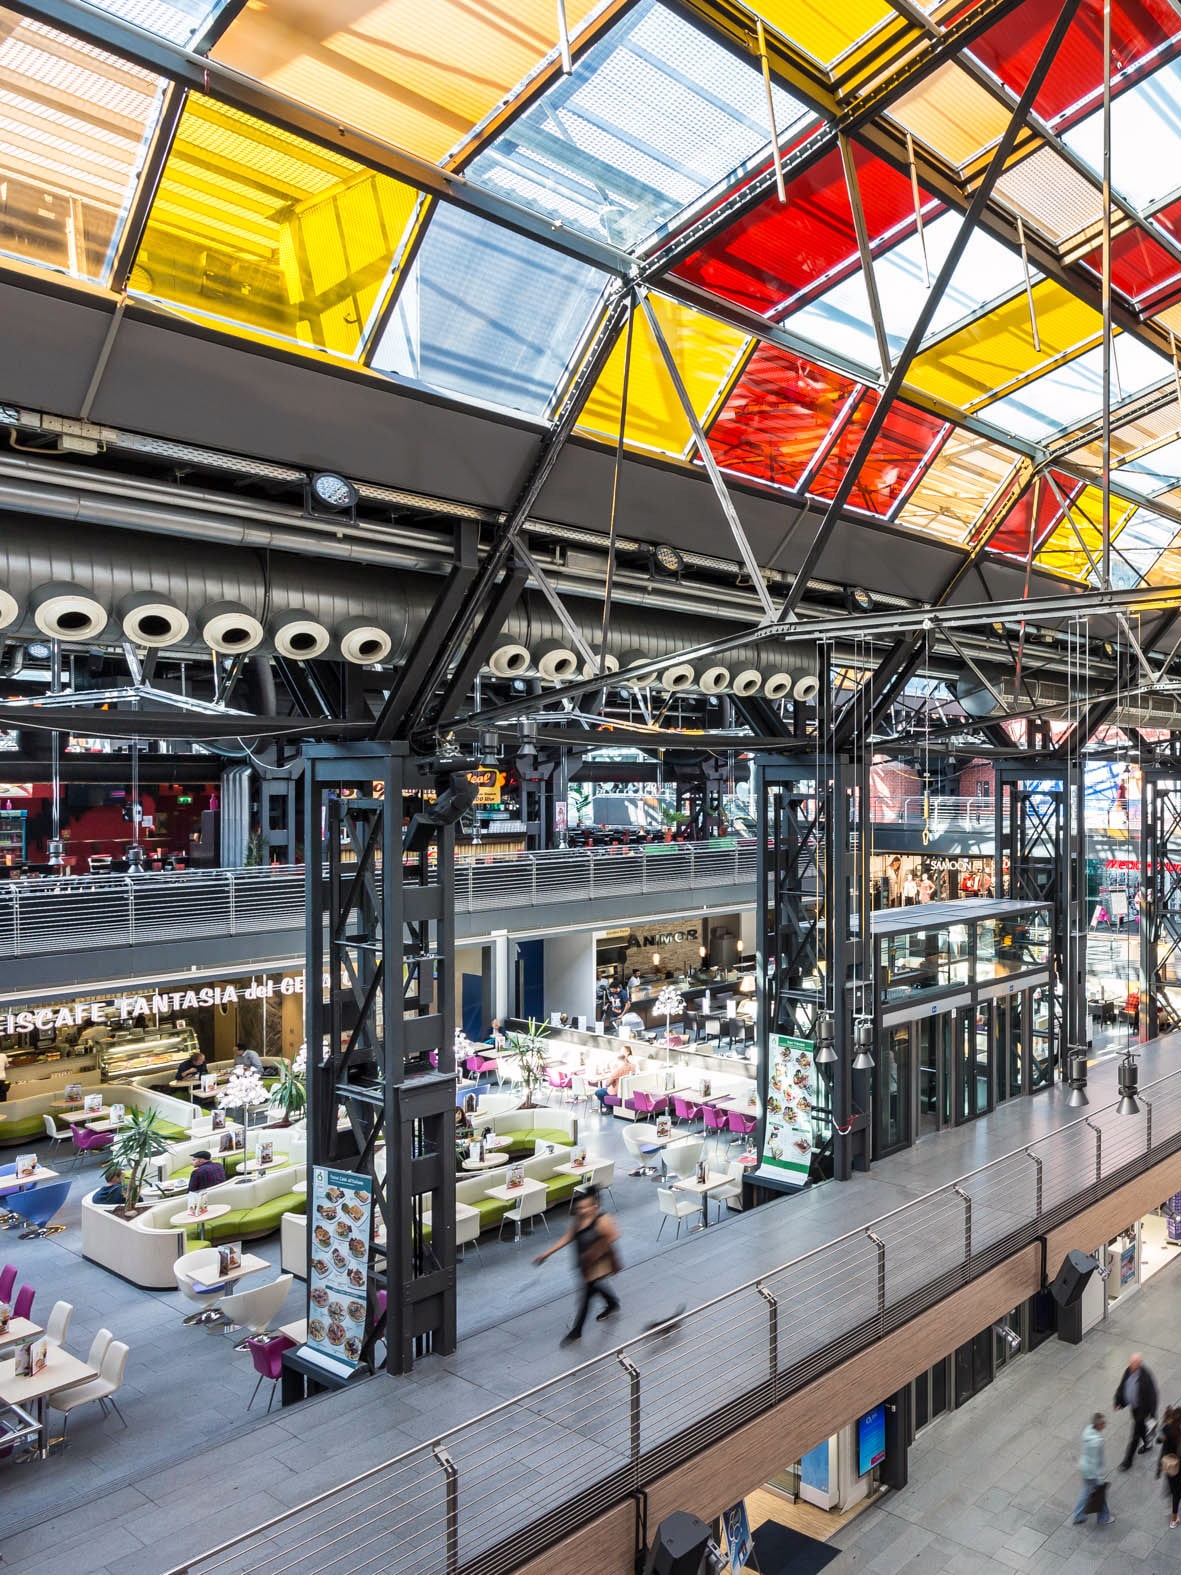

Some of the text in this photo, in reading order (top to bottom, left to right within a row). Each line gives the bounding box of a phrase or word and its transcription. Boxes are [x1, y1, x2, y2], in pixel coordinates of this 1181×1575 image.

[930, 859, 972, 871] SAMOON
[117, 984, 238, 1019] FANTASIA
[244, 979, 274, 1000] del
